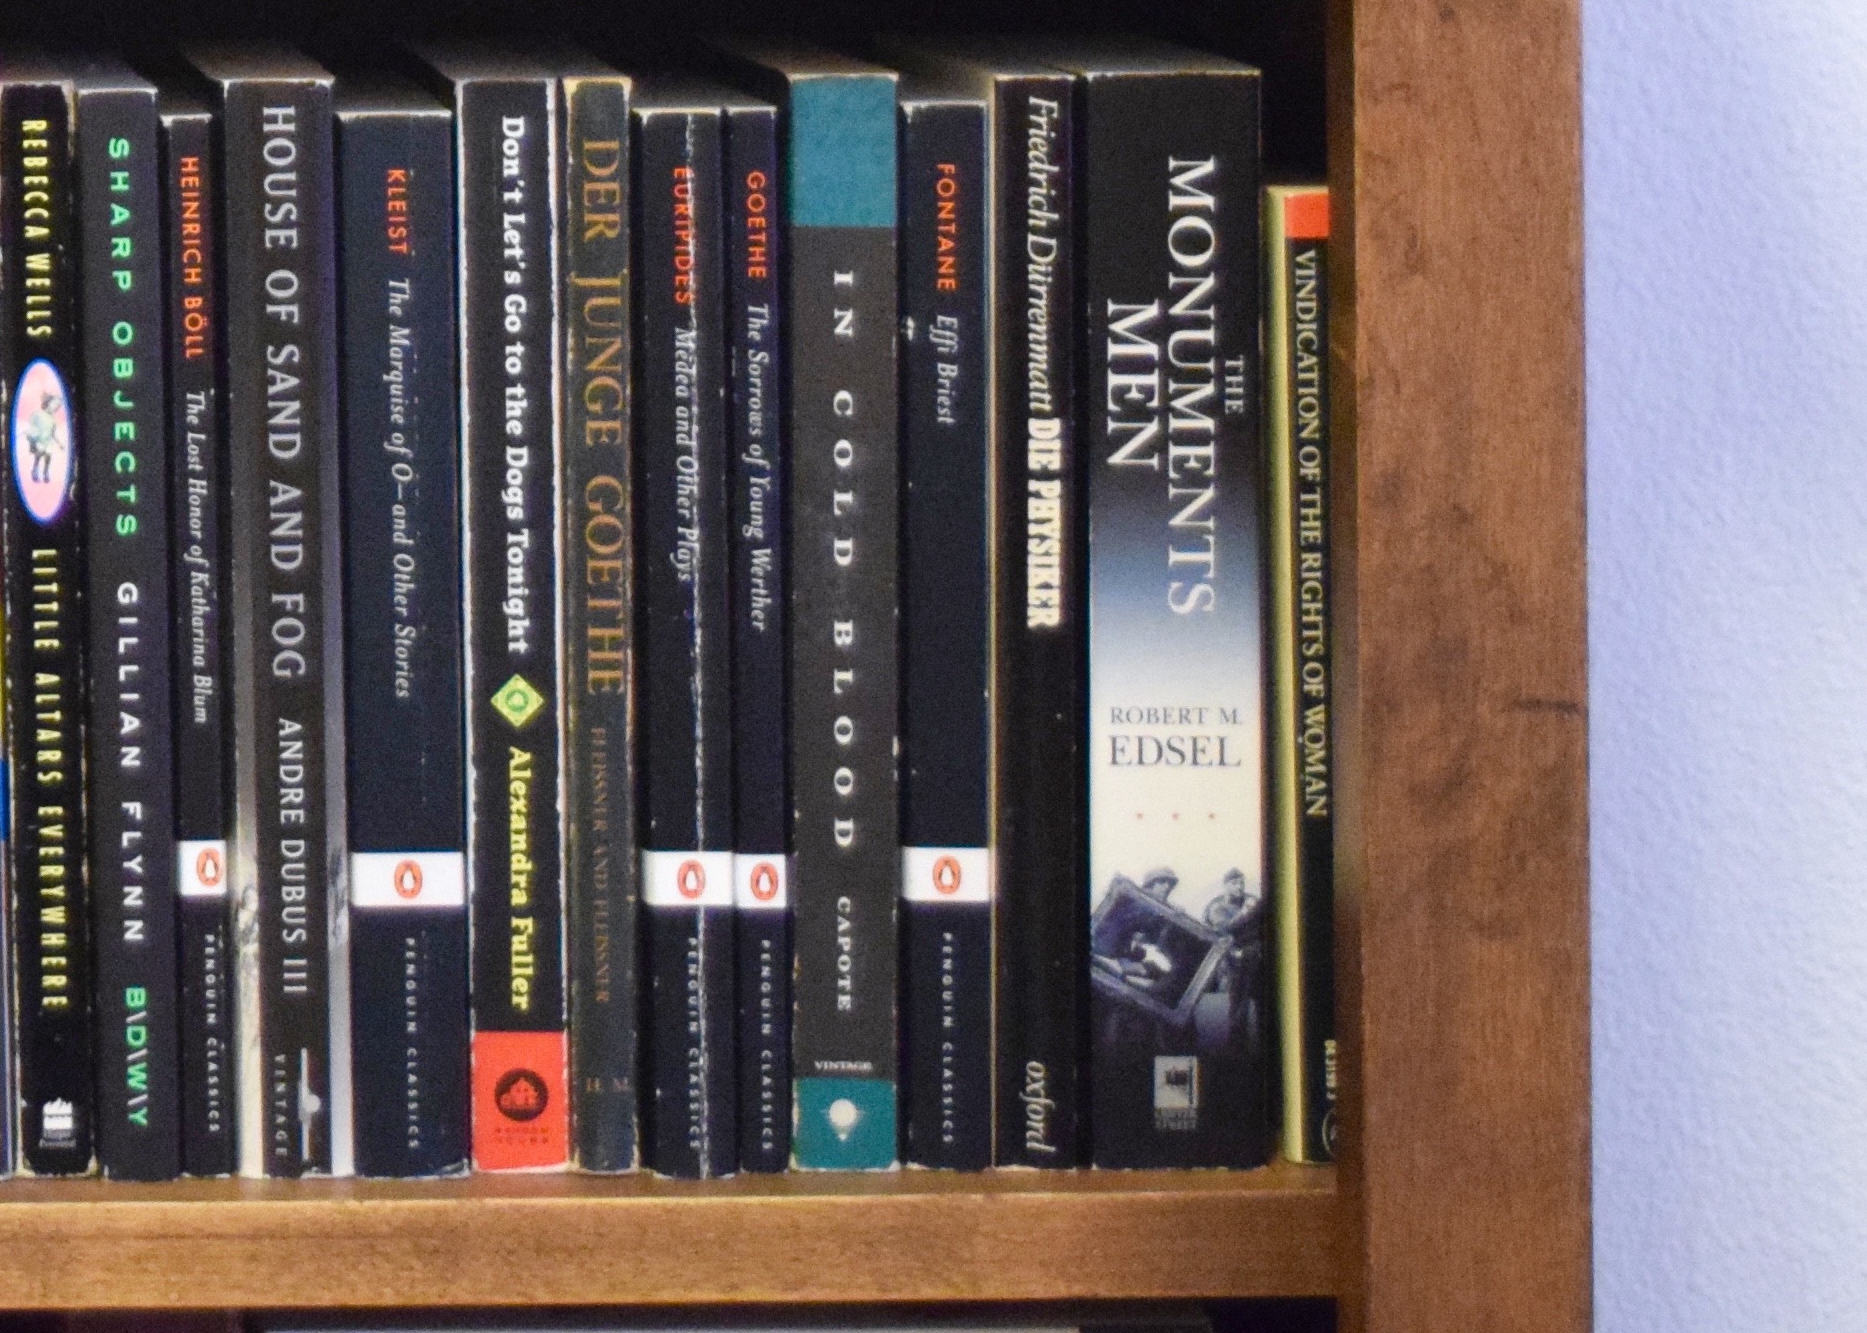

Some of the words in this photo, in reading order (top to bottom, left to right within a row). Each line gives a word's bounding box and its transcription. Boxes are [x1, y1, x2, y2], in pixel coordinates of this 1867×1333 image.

[263, 105, 297, 247] HOUSE
[502, 115, 527, 205] Don't
[108, 137, 132, 291] SHARP
[181, 158, 203, 284] HEINRICH
[503, 212, 527, 286] Let's
[184, 297, 204, 359] BÖLL
[265, 269, 299, 325] OF
[504, 293, 527, 333] Go
[834, 271, 854, 337] IN
[267, 344, 300, 458] SAND
[505, 342, 527, 374] to
[1107, 299, 1160, 470] MEN
[1167, 156, 1215, 615] MONUMENTS
[1225, 354, 1244, 414] THE
[113, 322, 137, 535] OBJECTS
[505, 382, 527, 436] the
[502, 446, 528, 521] Dogs
[833, 390, 854, 567] COLD
[270, 479, 303, 571] AND
[271, 592, 306, 679] FOG
[506, 532, 527, 654] Tonight
[833, 620, 854, 849] BLOOD
[1109, 736, 1242, 767] EDSEL
[1110, 707, 1209, 725] ROBERT
[1220, 707, 1242, 725] M.
[509, 746, 535, 906] Alexandra
[511, 916, 536, 1012] Fuller
